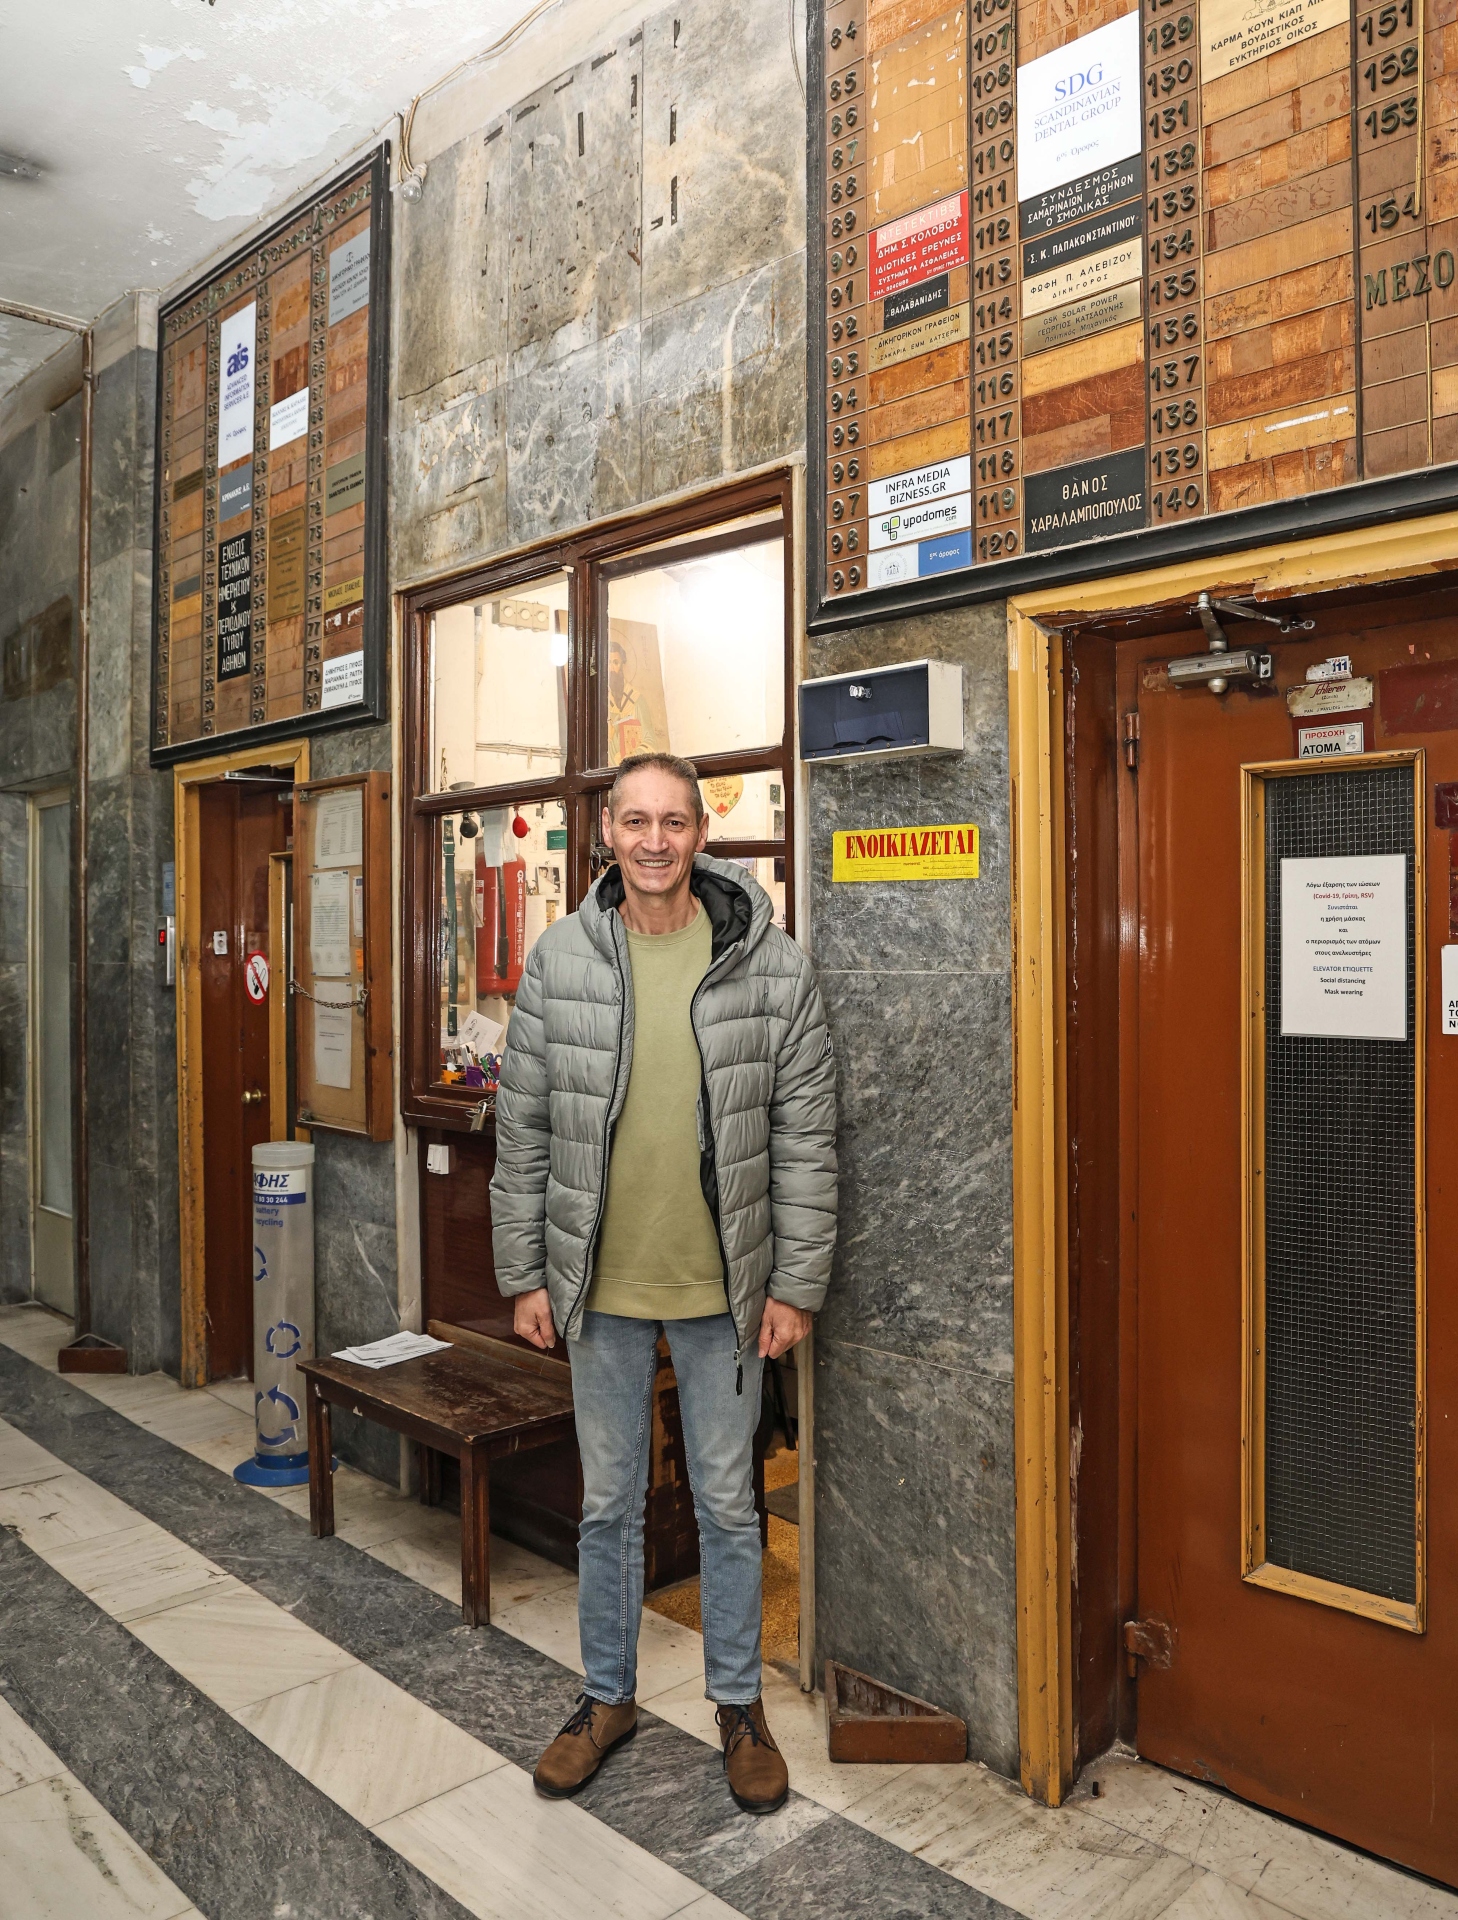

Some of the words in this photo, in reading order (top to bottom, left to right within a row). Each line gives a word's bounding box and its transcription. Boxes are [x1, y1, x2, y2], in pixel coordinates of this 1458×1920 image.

[830, 20, 857, 49] 84
[1148, 15, 1193, 55] 129
[1211, 32, 1243, 52] ΚΑΡΜΑ
[1248, 17, 1274, 34] ΚΟΥΝ
[1279, 4, 1302, 20] ΚΙΑΠ
[1241, 15, 1305, 49] ΒΟΥΔΙΣΤΙΚΟΣ
[1361, 0, 1412, 46] 151
[973, 23, 1010, 61] 107
[1230, 36, 1282, 66] ΕΥΚΤΗΡΙΟΣ
[1287, 21, 1318, 41] ΟΙΚΟΣ
[973, 62, 1010, 99] 108
[1054, 62, 1104, 103] SDG
[1147, 58, 1192, 98] 130
[1364, 46, 1418, 91] 152
[830, 70, 857, 100] 85
[832, 104, 858, 137] 86
[975, 100, 1013, 134] 109
[1034, 82, 1121, 130] SCANDINAVIAN
[1034, 117, 1079, 143] DENTAL
[1081, 96, 1122, 122] GROUP
[1148, 100, 1188, 139] 131
[1365, 96, 1417, 138] 153
[832, 139, 858, 169] 87
[975, 140, 1013, 174] 110
[1150, 142, 1195, 181] 132
[832, 175, 857, 203] 88
[975, 180, 1007, 213] 111
[1028, 194, 1083, 224] ΣΑΜΑΡΙΝΑΙΩΝ
[1094, 174, 1134, 198] ΑΘΗΝΩΝ
[1041, 167, 1119, 207] ΣΥΝΔΕΣΜΟΣ
[1057, 195, 1110, 224] ΣΜΟΛΙΚΑΣ
[1149, 184, 1195, 222] 133
[1365, 190, 1420, 233] 154
[832, 210, 857, 238] 89
[975, 217, 1010, 249] 112
[1040, 249, 1050, 260] Κ.
[1052, 215, 1136, 255] ΠΑΠΑΚΩΝΣΤΑΝΤΙΝΟΥ
[830, 245, 857, 273] 90
[922, 232, 962, 256] ΕΡΕΥΝΕΣ
[1150, 228, 1194, 264] 134
[878, 264, 918, 286] ΣΥΣΤΗΜΑΤΑ
[920, 247, 959, 269] ΑΣΦΑΛΕΙΑΣ
[975, 258, 1011, 288] 113
[1031, 279, 1057, 295] ΦΩΦΗ
[1080, 252, 1132, 278] ΑΛΕΒΙΖΟΥ
[831, 280, 853, 307] 91
[1053, 274, 1109, 299] ΔΙΚΗΓΟΡΟΣ
[1151, 268, 1197, 305] 135
[890, 289, 943, 317] ΒΑΛΑΒΑΝΙΔΗΣ
[976, 296, 1012, 329] 114
[1043, 315, 1058, 326] GSK
[1062, 305, 1087, 319] SOLAR
[1090, 294, 1118, 309] POWER
[832, 315, 858, 342] 92
[878, 327, 922, 348] ΔΙΚΗΓΟΡΙΚΟΝ
[925, 312, 960, 331] ΓΡΑΦΕΙΟΝ
[1038, 322, 1072, 337] ΓΕΩΡΓΙΟΣ
[1151, 312, 1198, 348] 136
[226, 342, 249, 378] ais
[976, 332, 1013, 364] 115
[831, 350, 859, 378] 93
[1150, 354, 1200, 392] 137
[831, 386, 858, 413] 94
[976, 372, 1013, 404] 116
[977, 410, 1013, 442] 117
[1152, 398, 1198, 433] 138
[832, 420, 859, 446] 95
[832, 457, 859, 483] 96
[978, 449, 1014, 480] 118
[1152, 443, 1199, 477] 139
[885, 478, 915, 494] INFRA
[917, 467, 951, 485] MEDIA
[890, 482, 947, 505] BIZNESS.GR
[1063, 474, 1108, 500] ΘΑΝΟΣ
[832, 492, 860, 520] 97
[978, 488, 1015, 518] 119
[1031, 493, 1142, 534] ΧΑΡΑΛΑΜΠΟΠΟΥΛΟΣ
[1152, 483, 1200, 517] 140
[903, 506, 957, 529] ypodomes
[223, 538, 246, 563] ΕΝΩΣΙΣ
[832, 528, 858, 553] 98
[979, 530, 1017, 559] 120
[221, 556, 250, 582] ΤΕΧΝΙΚΩΝ
[308, 572, 321, 589] 75
[833, 566, 860, 591] 99
[218, 576, 251, 603] ΗΜΕΡΗΣΙΟΥ
[218, 610, 251, 636] ΠΕΡΙΟΔΙΚΟΥ
[308, 621, 321, 637] 77
[222, 631, 244, 653] ΤΥΠΟΥ
[222, 651, 247, 675] ΑΘΗΝΩΝ
[1310, 682, 1347, 699] Schlieren
[1302, 742, 1341, 755] ΑΤΟΜΑ
[1305, 729, 1345, 740] ΠΡΟΣΟΧΗ
[846, 830, 975, 860] ΕΝΟΙΚΙΑΖΕΤΑΙ
[1306, 881, 1322, 889] Λόγω
[1342, 892, 1360, 900] Γρίπη,
[1361, 892, 1374, 900] RSV)
